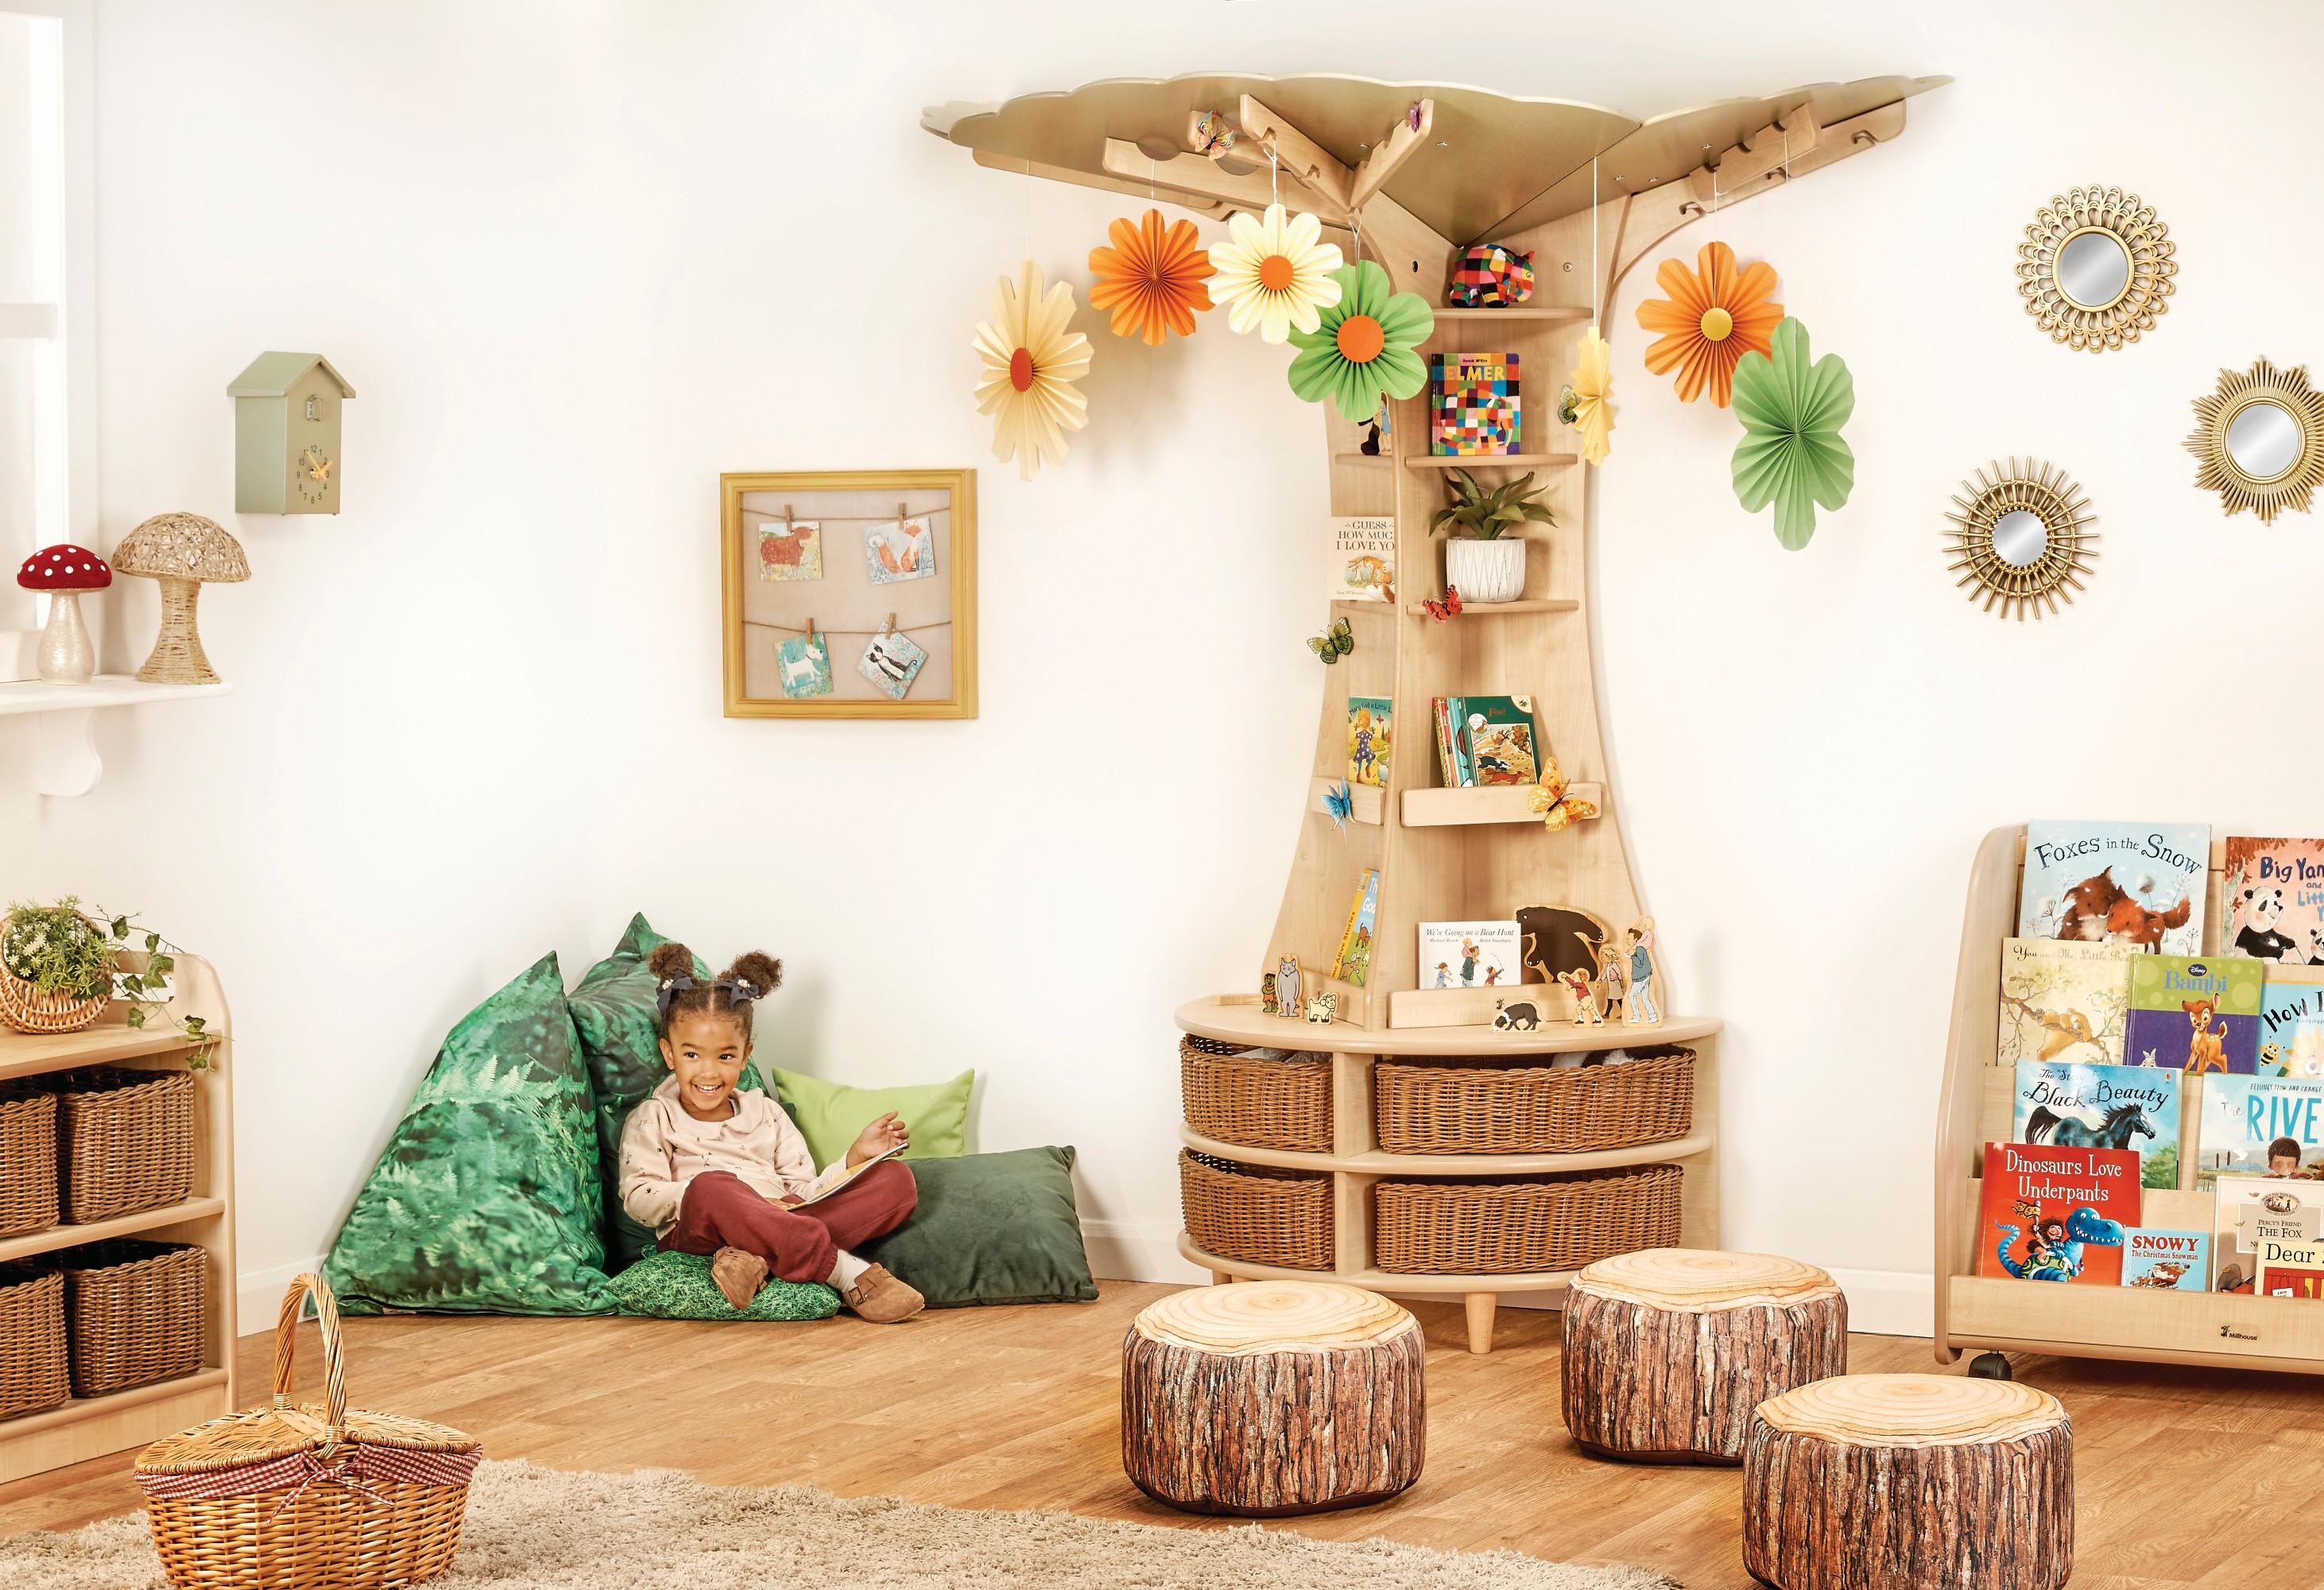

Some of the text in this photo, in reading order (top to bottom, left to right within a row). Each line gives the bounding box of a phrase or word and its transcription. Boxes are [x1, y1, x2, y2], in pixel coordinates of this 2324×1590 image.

[1447, 366, 1505, 382] ELMER
[304, 492, 307, 501] 7
[1352, 521, 1387, 529] GUESS
[1336, 541, 1341, 550] I
[1345, 541, 1376, 550] LOVE
[1349, 706, 1361, 716] Mary
[2034, 834, 2202, 874] Foxes in the Snow
[2260, 856, 2292, 883] Big
[1445, 929, 1464, 937] Going
[2013, 944, 2037, 961] You
[2057, 948, 2077, 960] Me,
[2078, 948, 2107, 961] Little
[2189, 966, 2206, 975] Disney
[2163, 970, 2228, 995] Bambi
[2039, 1068, 2055, 1080] The
[2023, 1080, 2169, 1112] Black Beauty
[2246, 1094, 2322, 1144] RIVE
[2005, 1150, 2122, 1177] Dinosaurs Love
[2019, 1176, 2109, 1204] Underpants
[2256, 1227, 2302, 1238] THE FOX
[2132, 1235, 2199, 1251] SNOWY
[2265, 1243, 2315, 1263] Dear
[2229, 1332, 2257, 1341] Millhouse
